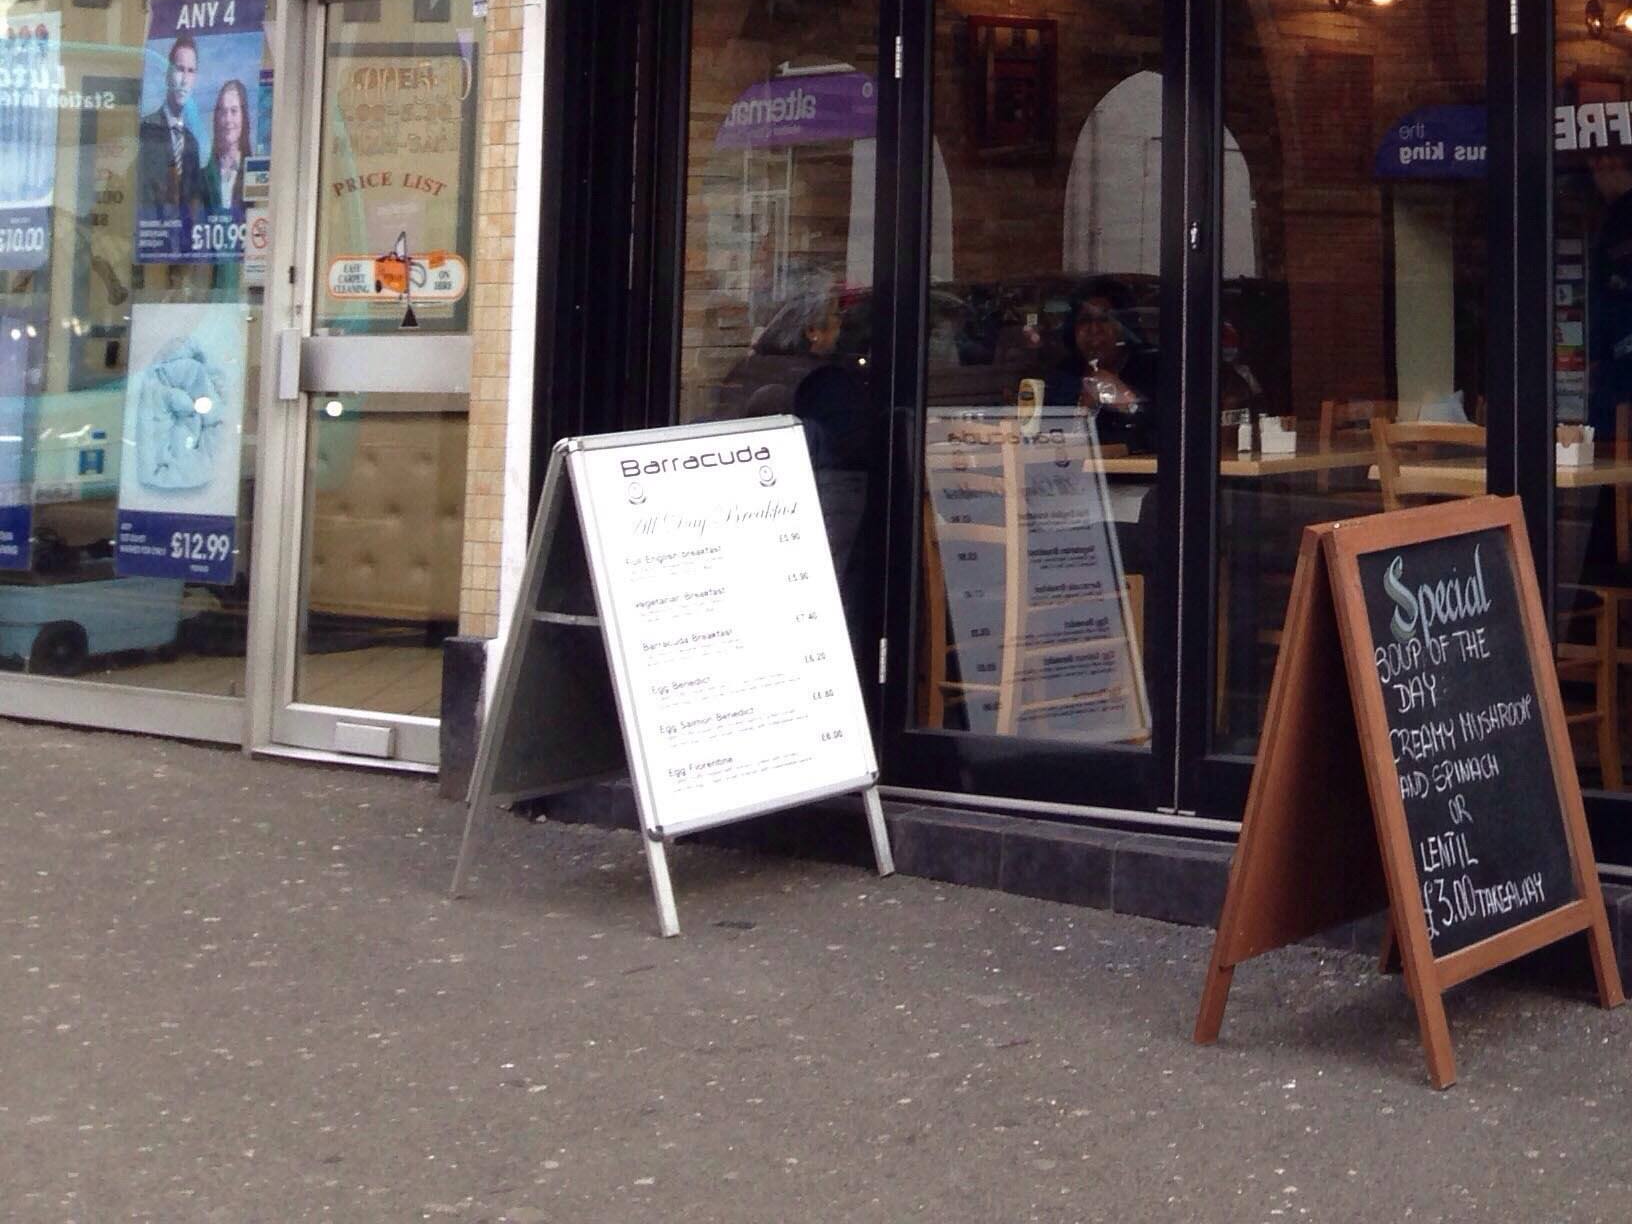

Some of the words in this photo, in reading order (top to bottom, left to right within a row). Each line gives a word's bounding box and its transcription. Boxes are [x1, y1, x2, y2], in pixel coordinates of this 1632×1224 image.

[176, 2, 219, 30] ANY
[224, 0, 236, 26] 4
[333, 171, 393, 198] PRICE
[403, 173, 448, 196] LIST
[191, 223, 246, 251] £10.99
[620, 445, 771, 477] Barracuda
[170, 531, 230, 560] £12.99
[1383, 543, 1492, 648] Special
[1375, 637, 1422, 684] SOUP
[1428, 634, 1450, 665] OF
[1452, 627, 1490, 662] THE
[1389, 718, 1457, 764] CREAMY
[1459, 693, 1533, 743] MUSHROOM
[1400, 771, 1429, 800] AND
[1431, 752, 1500, 793] SPINACH
[1448, 793, 1474, 824] OR
[1420, 831, 1479, 872] LENTIL
[1423, 874, 1477, 941] £3.00
[1475, 871, 1546, 919] TAKEAWAY
